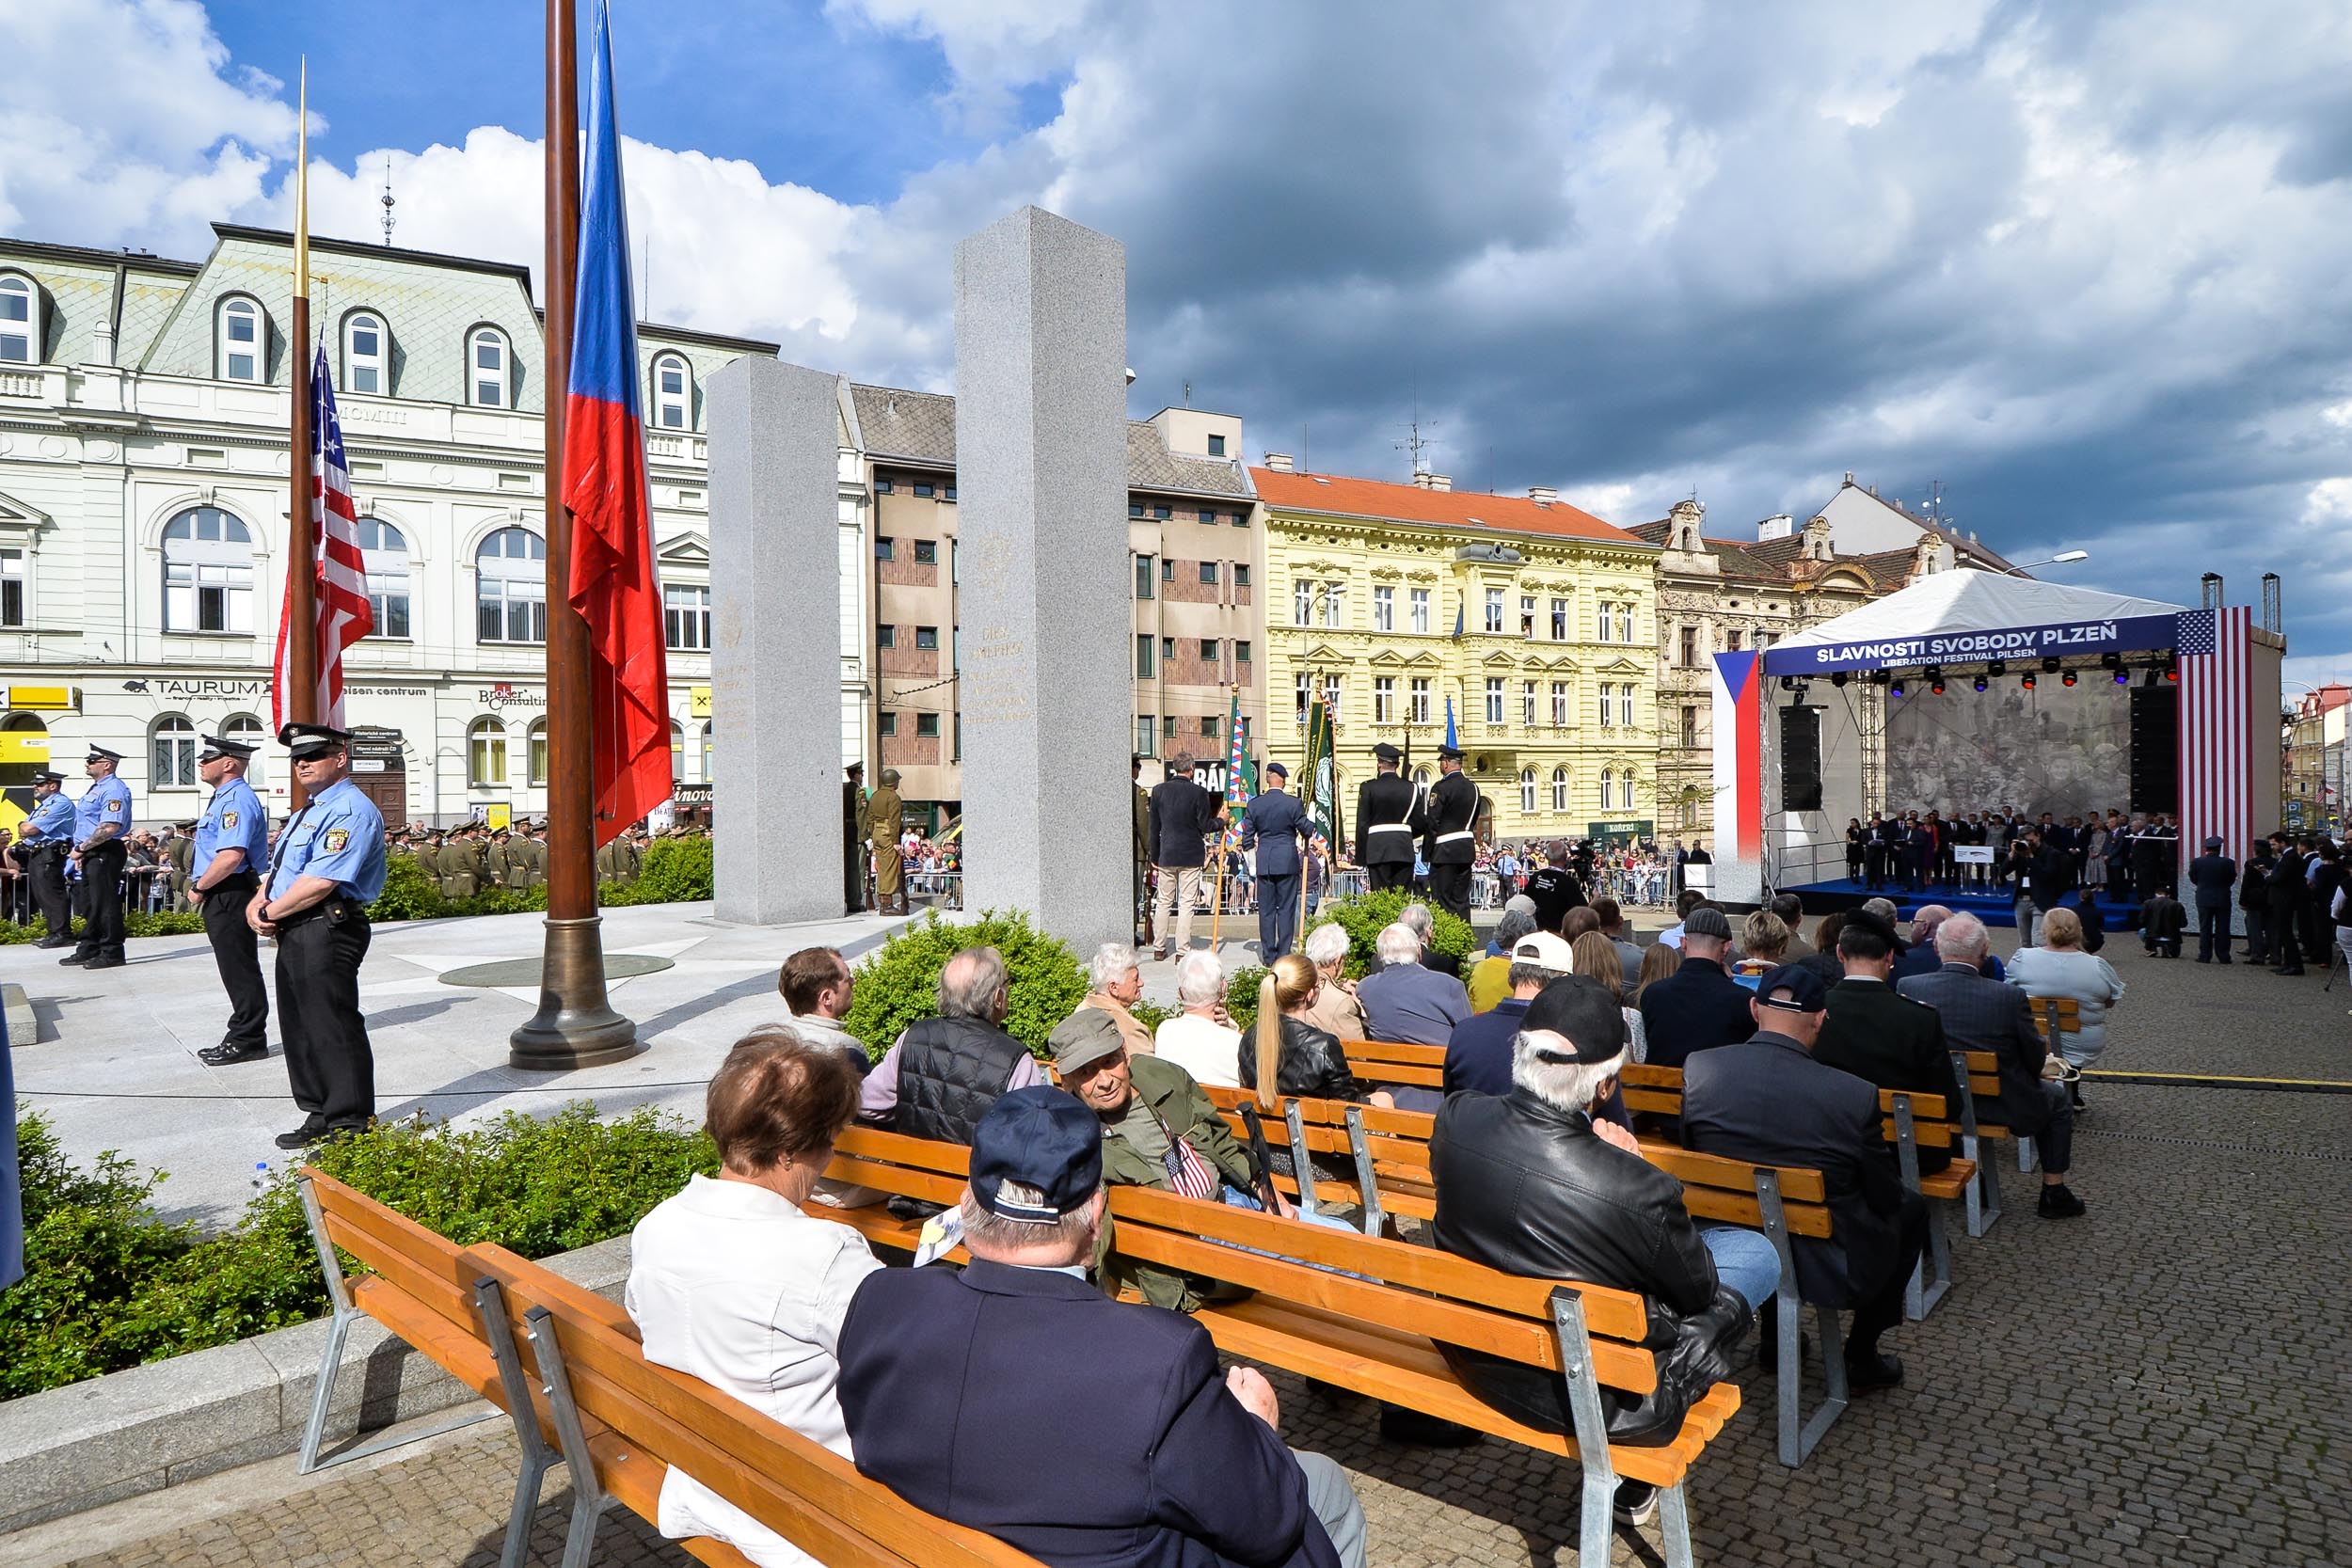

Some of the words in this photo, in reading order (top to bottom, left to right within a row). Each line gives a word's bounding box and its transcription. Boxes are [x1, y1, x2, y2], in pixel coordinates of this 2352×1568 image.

[1817, 641, 1925, 662] SLAVNOSTI
[1931, 631, 2037, 654] SVOBODY
[2042, 620, 2117, 645] PLZEŇ
[1882, 655, 1942, 668] LIBERATION
[1944, 651, 1994, 663] FESTIVAL
[1997, 648, 2037, 659] PILSEN
[154, 680, 258, 694] TAURUM
[376, 688, 427, 696] centrum
